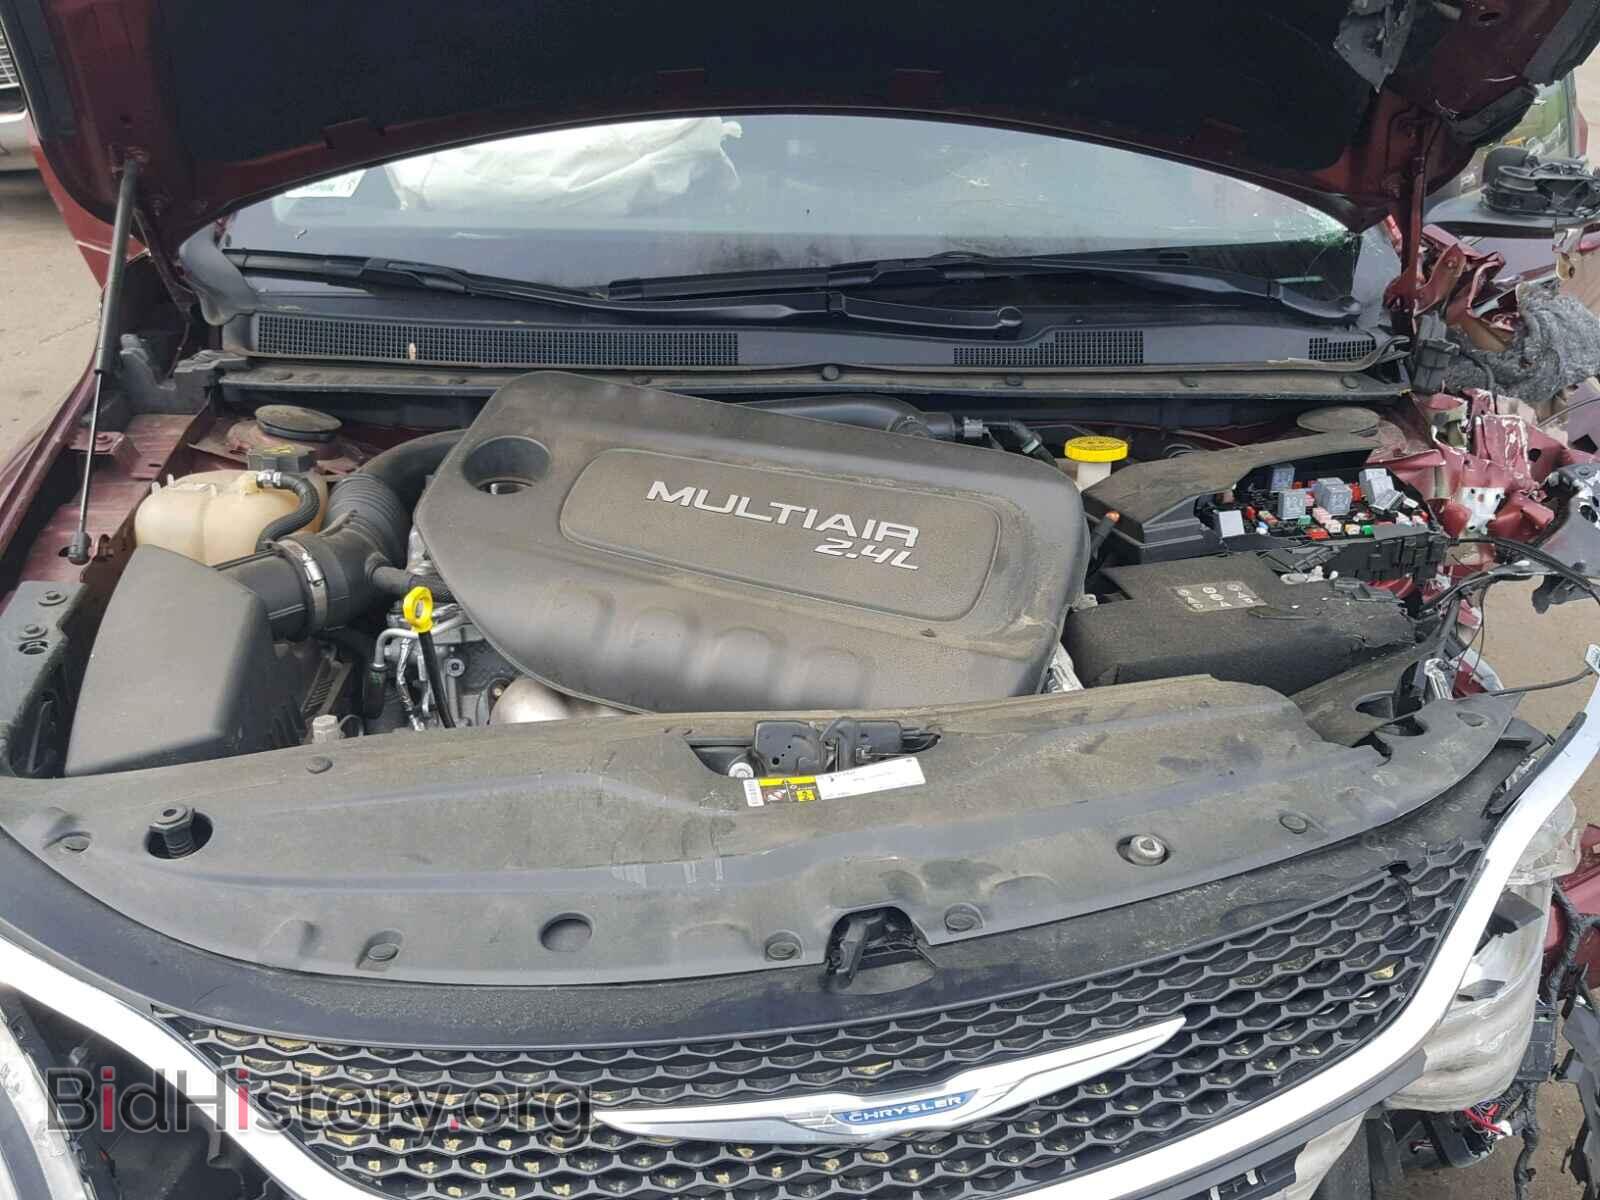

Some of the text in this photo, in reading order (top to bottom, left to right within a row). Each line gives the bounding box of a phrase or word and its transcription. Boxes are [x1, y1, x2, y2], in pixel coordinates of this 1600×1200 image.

[646, 480, 920, 548] MULTIAIR
[814, 537, 919, 571] 2.4L
[848, 1095, 963, 1123] CHRYSLER
